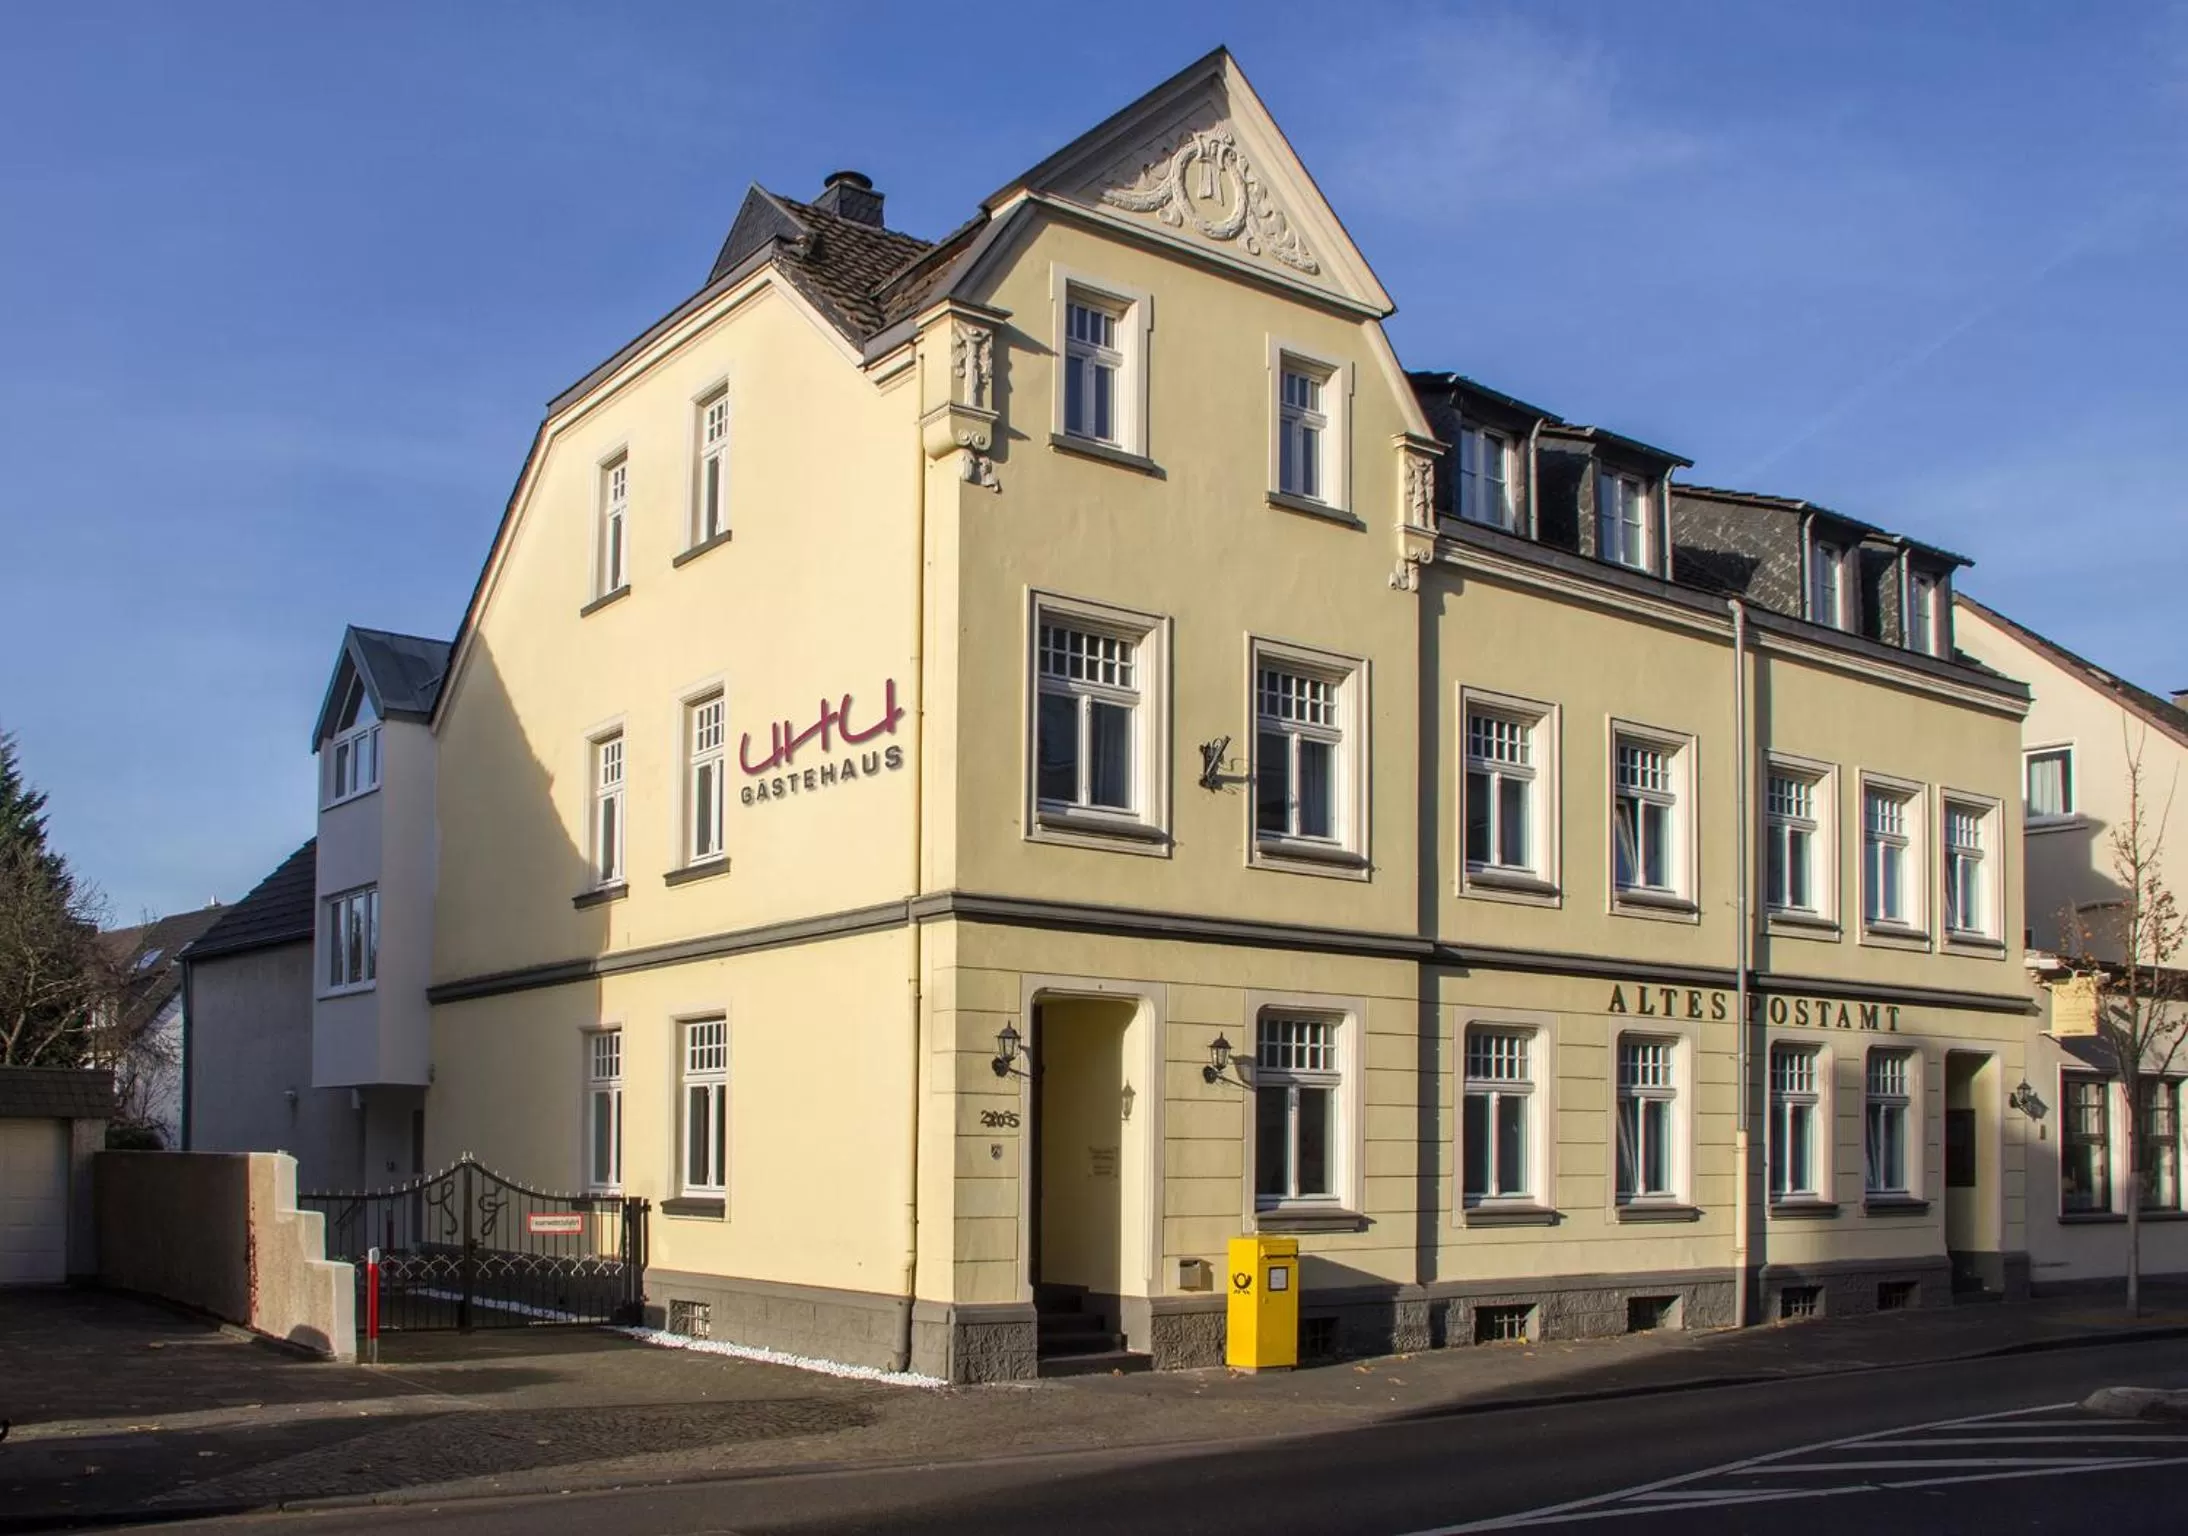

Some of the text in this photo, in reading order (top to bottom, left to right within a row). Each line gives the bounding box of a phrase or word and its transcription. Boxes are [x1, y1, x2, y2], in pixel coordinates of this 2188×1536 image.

[740, 678, 904, 775] UHU
[740, 745, 902, 805] GÄSTEHAUS
[1607, 984, 1900, 1031] ALTES POSTAMT
